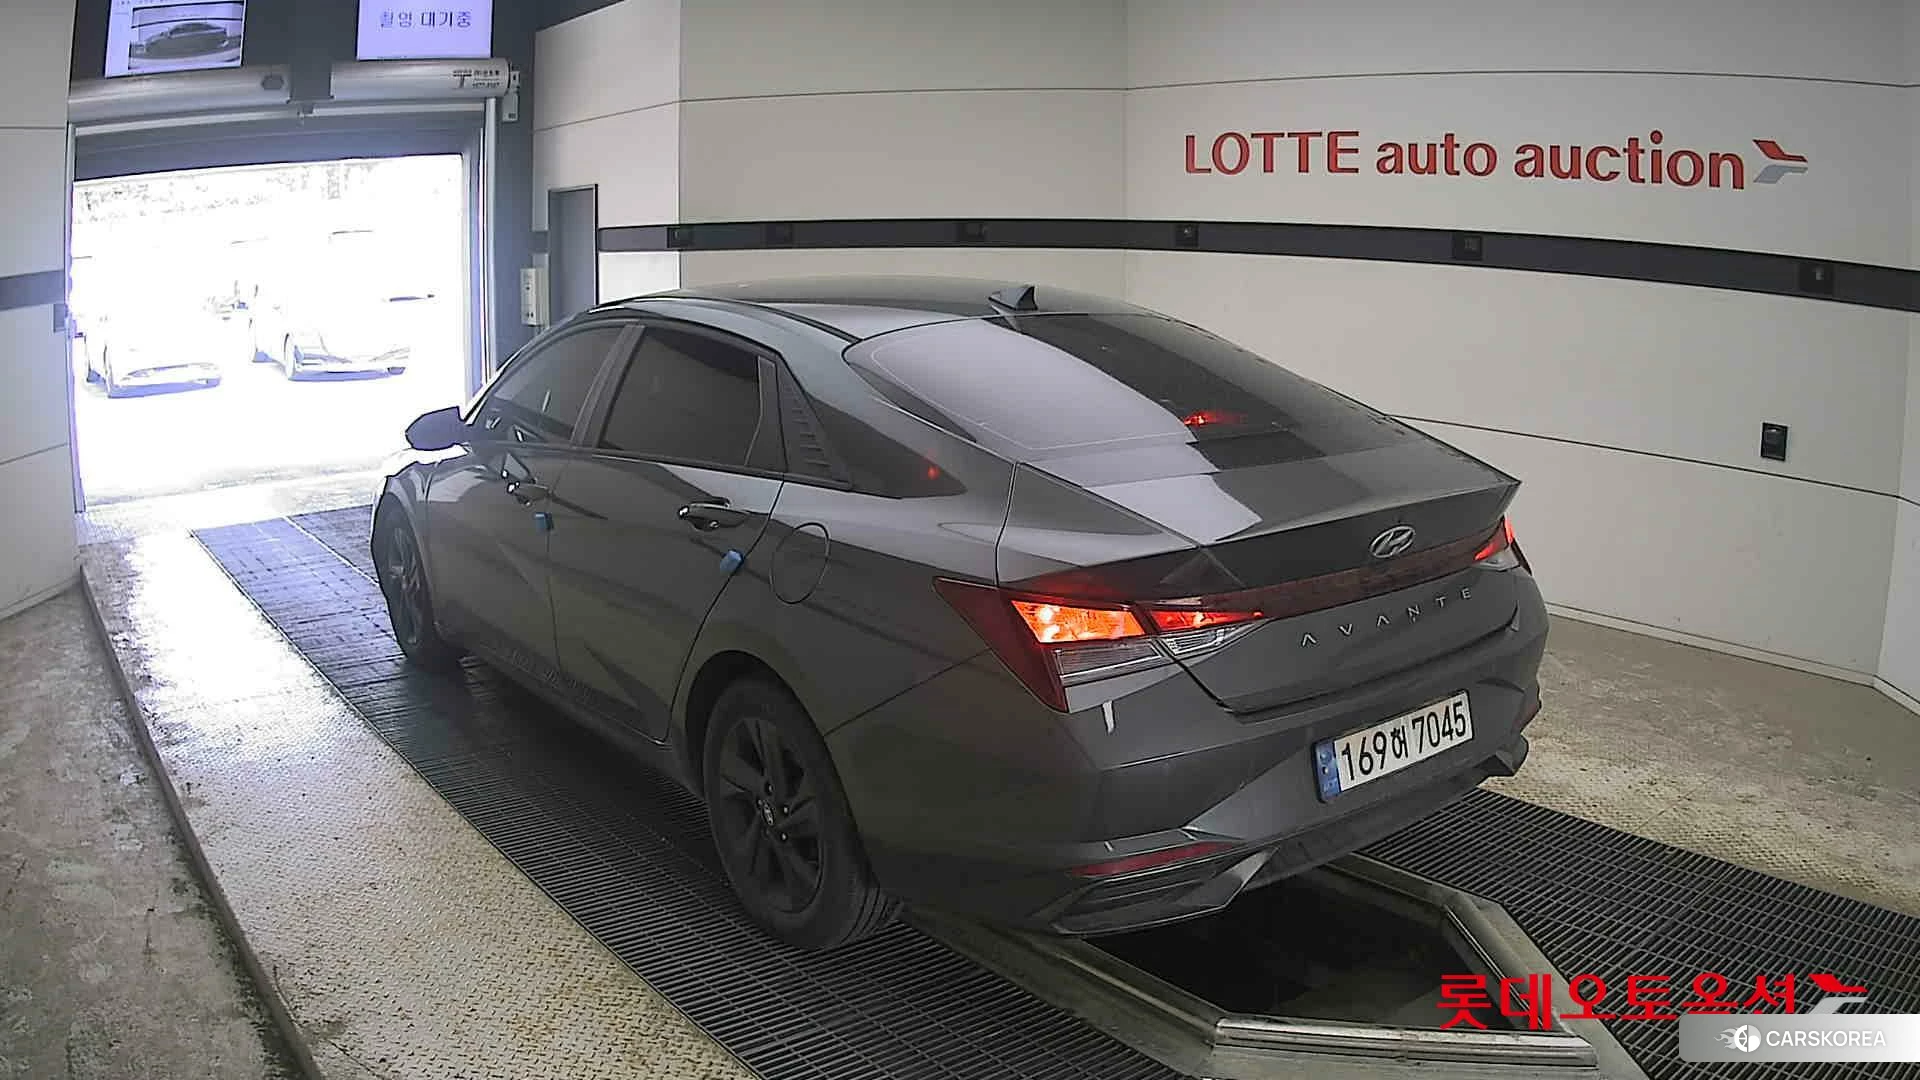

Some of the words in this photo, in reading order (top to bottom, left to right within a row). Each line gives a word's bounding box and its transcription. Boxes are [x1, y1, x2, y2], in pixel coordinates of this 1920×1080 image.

[1184, 131, 1359, 176] LOTTE
[1376, 134, 1497, 177] auto
[1514, 130, 1745, 190] auction
[1300, 588, 1472, 648] AVANTE
[1341, 726, 1409, 780] 169허
[1411, 701, 1467, 754] 7045
